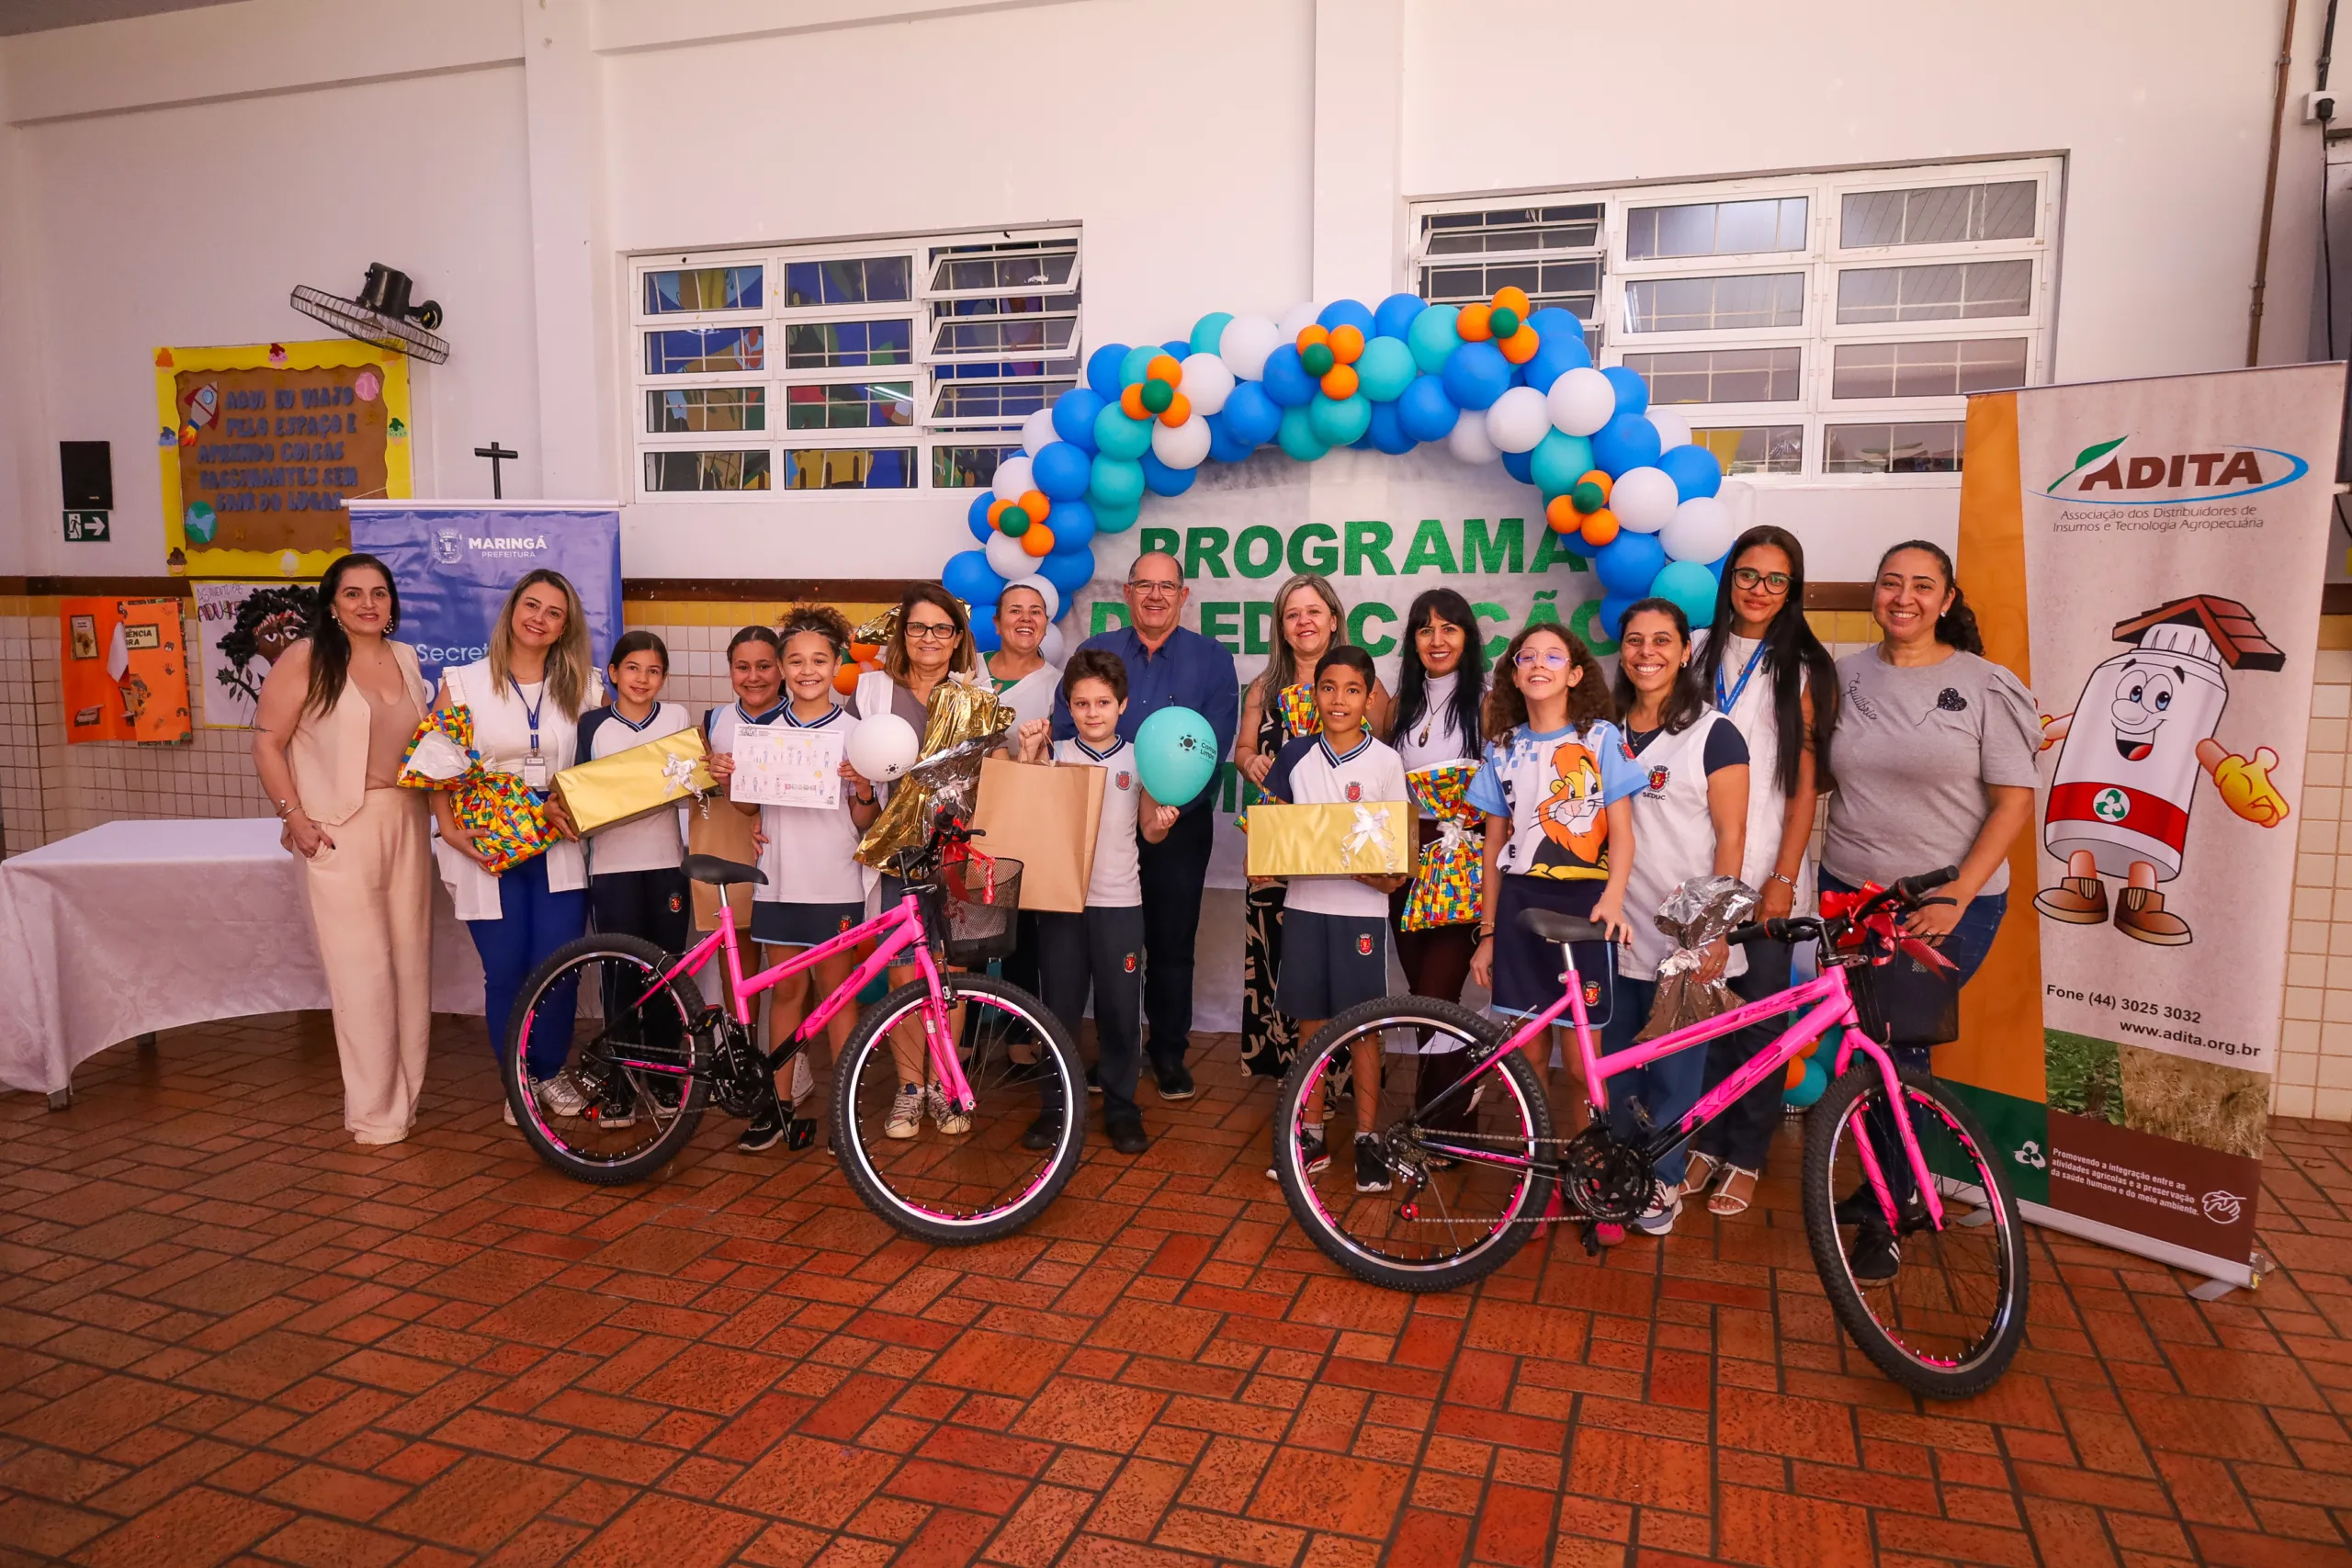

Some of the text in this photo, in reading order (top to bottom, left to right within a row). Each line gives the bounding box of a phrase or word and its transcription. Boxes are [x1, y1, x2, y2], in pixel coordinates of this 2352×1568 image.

[225, 386, 355, 410] AQUI EU VIAJO
[275, 413, 342, 439] ESPAÇO
[346, 412, 357, 434] E
[322, 467, 358, 487] SEM
[2077, 451, 2264, 491] ADITA
[260, 492, 282, 512] DO
[2060, 505, 2257, 522] Associação dos Distribuidores de
[2052, 523, 2100, 533] Insumos
[2115, 520, 2177, 533] Tecnologia
[2179, 517, 2264, 532] Agropecuária
[469, 535, 548, 550] MARINGÁ
[1140, 517, 1589, 579] PROGRAMA
[1642, 791, 1666, 801] SEDUC
[2046, 984, 2201, 1024] Fone (44) 3025 3032
[2120, 1021, 2261, 1056] www.adita.org.br
[2052, 1147, 2100, 1168] Promovendo
[2109, 1162, 2151, 1181] integração
[2152, 1175, 2174, 1188] entre
[2176, 1181, 2187, 1190] as
[2052, 1158, 2090, 1176] atividades
[2129, 1179, 2134, 1188] e
[2136, 1181, 2142, 1190] a
[2143, 1183, 2196, 1204] preservação
[2051, 1168, 2061, 1178] da
[2062, 1171, 2085, 1184] saúde
[2086, 1178, 2117, 1193] humana
[2125, 1189, 2136, 1199] do
[2137, 1192, 2158, 1204] meio
[2159, 1198, 2199, 1216] ambiente.
